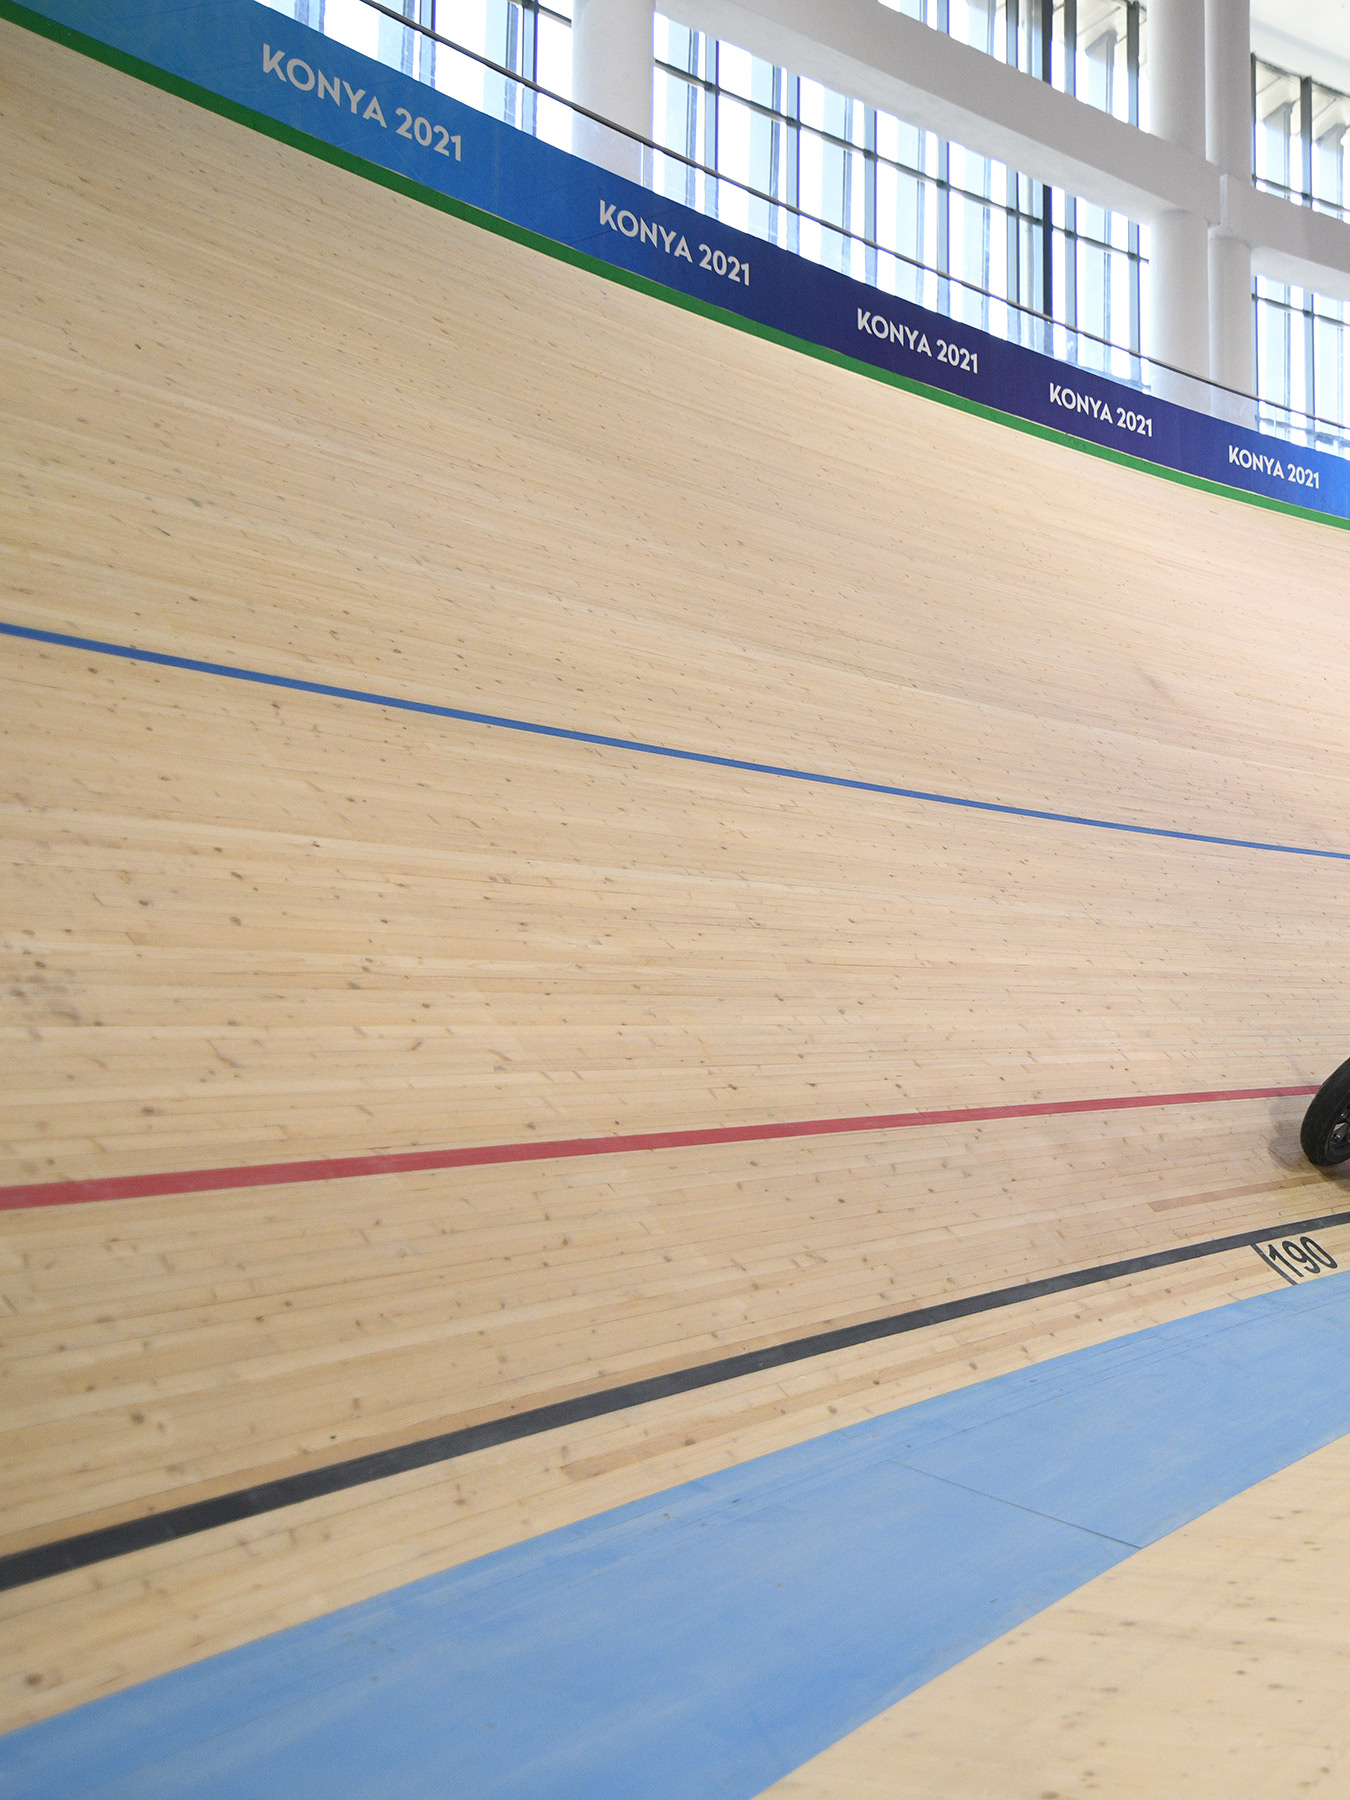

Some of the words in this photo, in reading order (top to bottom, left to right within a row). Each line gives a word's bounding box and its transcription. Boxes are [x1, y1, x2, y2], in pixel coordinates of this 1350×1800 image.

[262, 43, 388, 129] KONYA
[395, 107, 462, 162] 2021
[599, 199, 693, 263] KONYA
[698, 243, 750, 287] 2021
[857, 307, 933, 357] KONYA
[936, 339, 978, 374] 2021
[1049, 382, 1114, 424] KONYA
[1116, 407, 1153, 438] 2021
[1228, 445, 1285, 479] KONYA
[1287, 463, 1320, 489] 2021
[1267, 1236, 1338, 1278] 190
